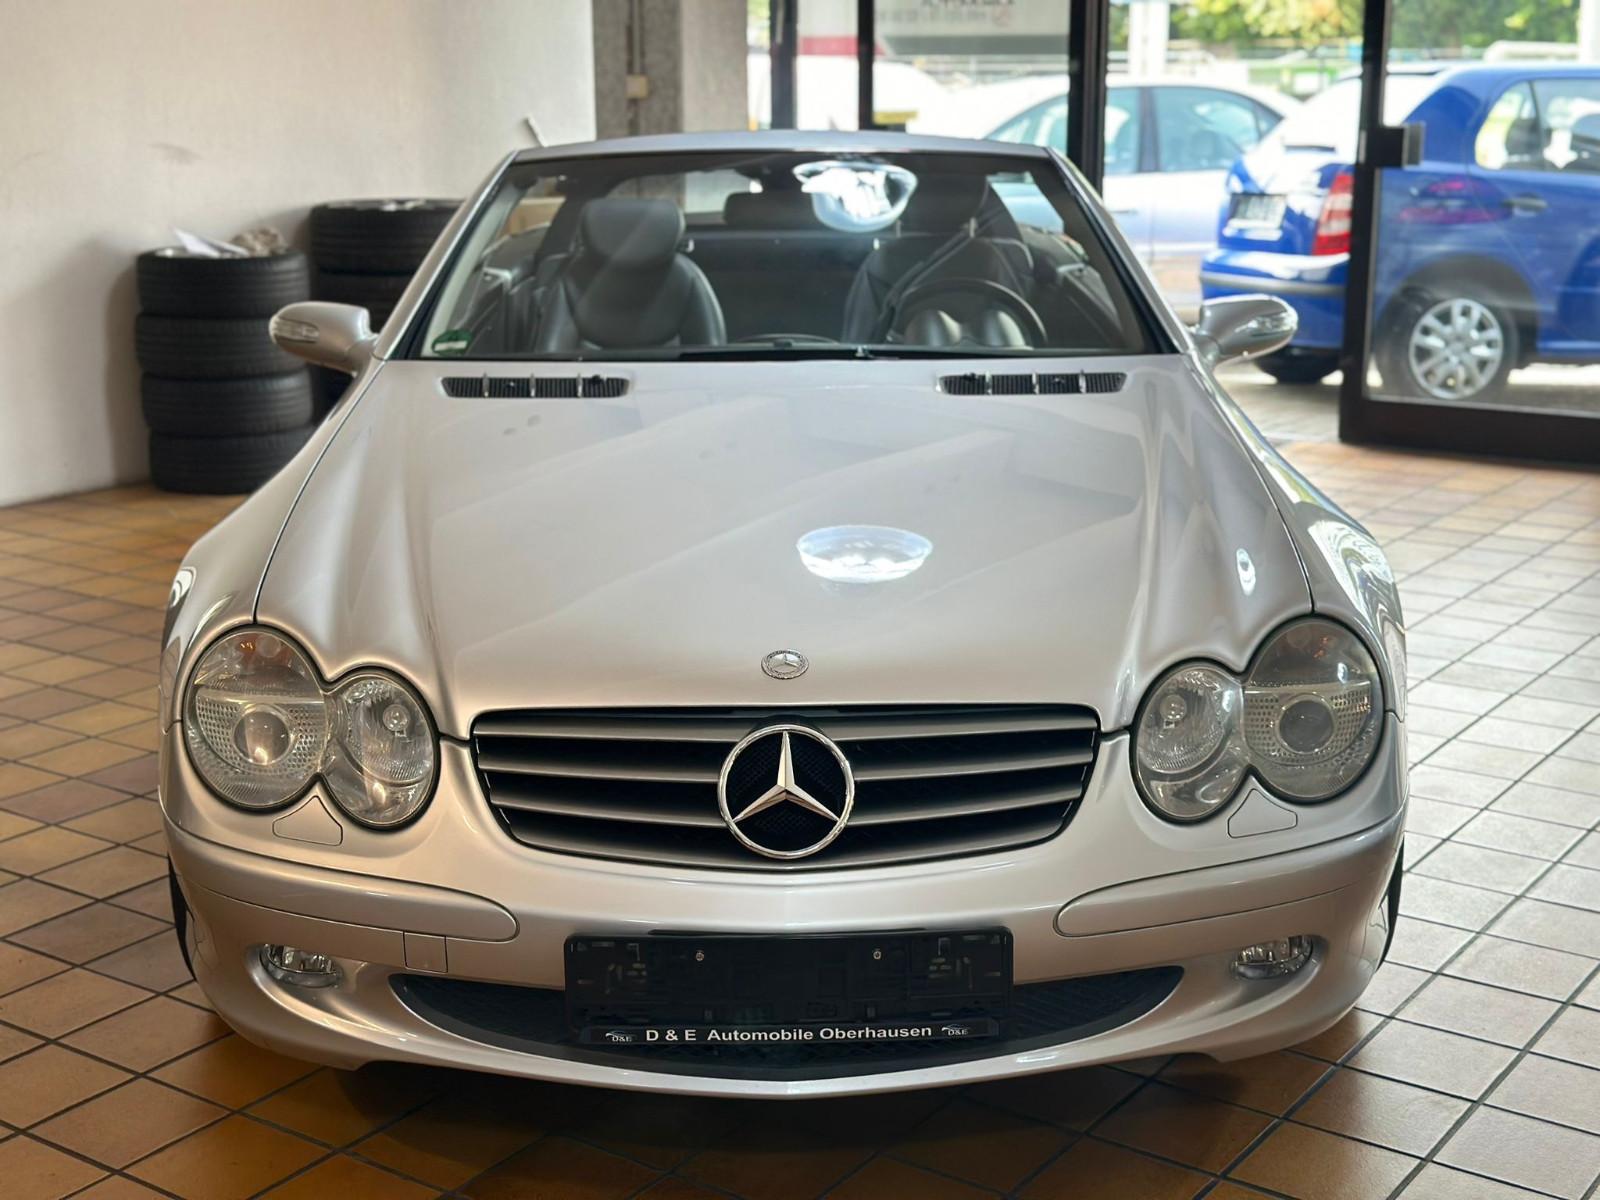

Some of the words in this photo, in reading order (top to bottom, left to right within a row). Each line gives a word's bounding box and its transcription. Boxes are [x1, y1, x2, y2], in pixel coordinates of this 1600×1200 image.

[646, 1030, 659, 1041] D
[665, 1030, 679, 1041] &
[685, 1030, 697, 1041] E
[707, 1029, 814, 1041] Automobile
[819, 1026, 932, 1040] Oberhausen
